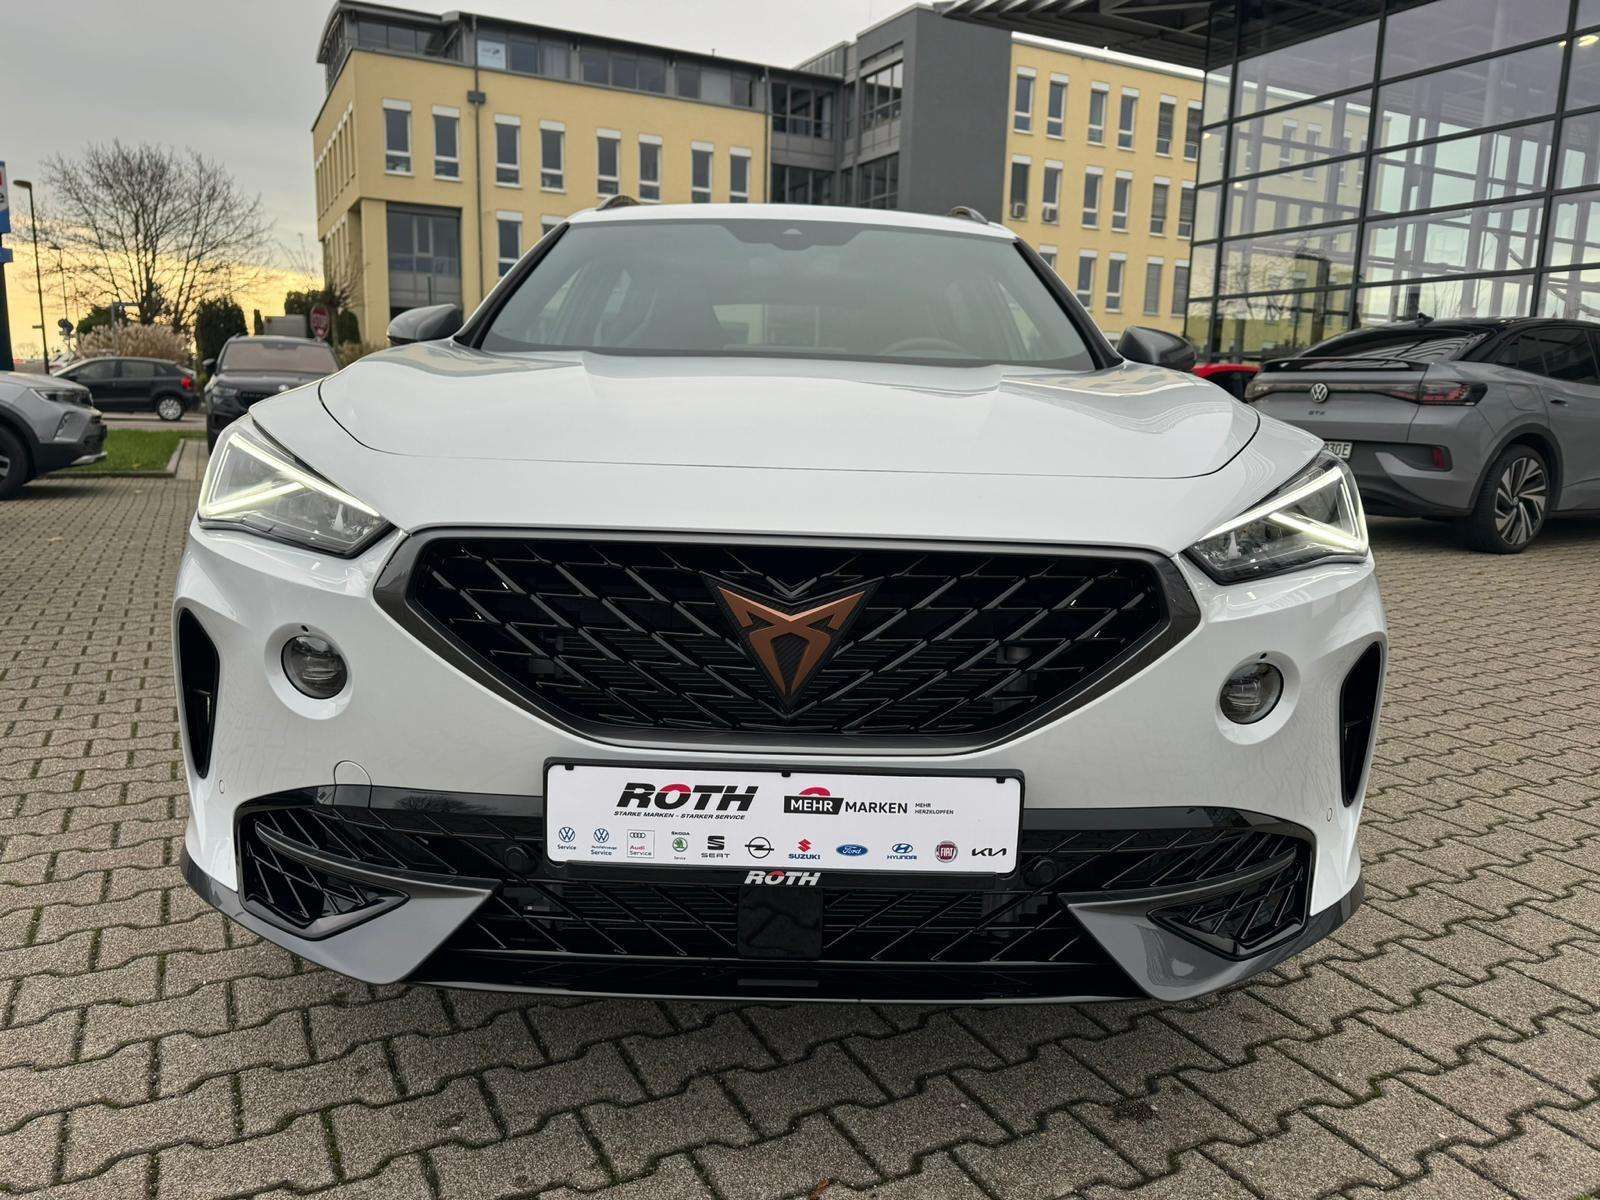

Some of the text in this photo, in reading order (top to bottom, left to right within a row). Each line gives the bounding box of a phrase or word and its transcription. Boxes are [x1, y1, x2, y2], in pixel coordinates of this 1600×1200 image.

[616, 782, 760, 812] ROTH
[790, 799, 908, 814] MEHR MARKEN
[842, 846, 862, 855] Ford
[939, 847, 955, 857] FIAT
[744, 870, 821, 886] ROTH
